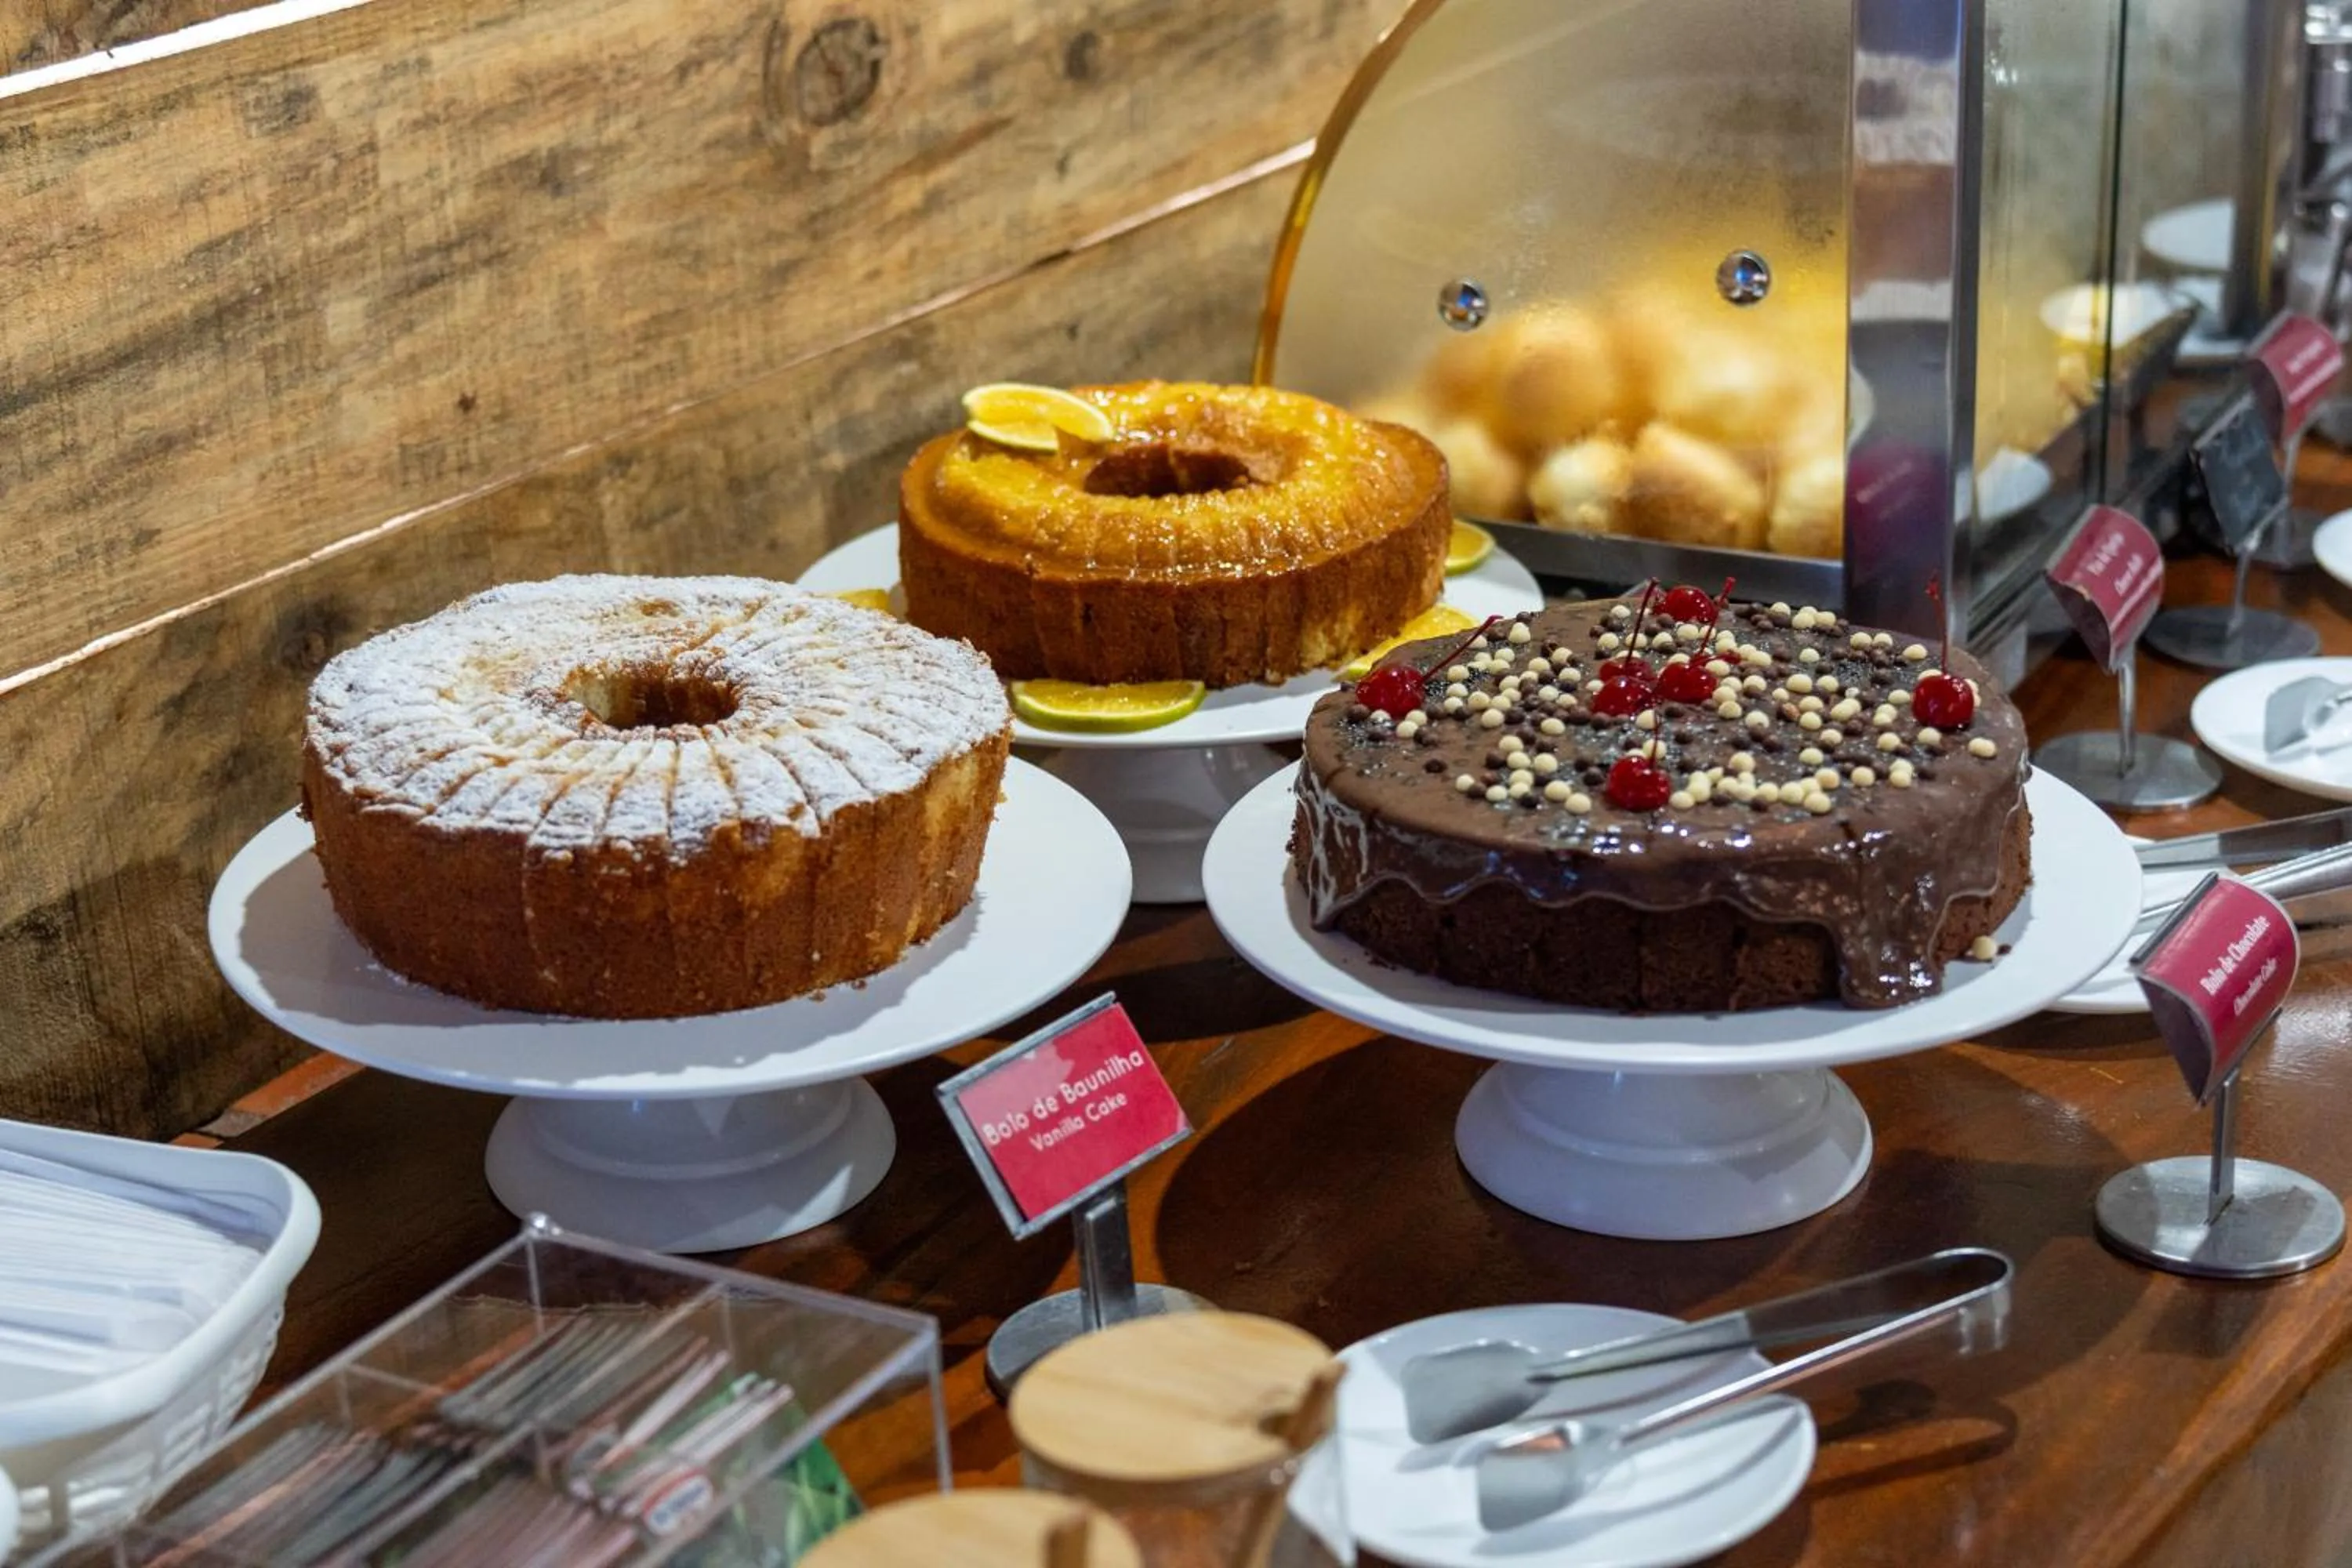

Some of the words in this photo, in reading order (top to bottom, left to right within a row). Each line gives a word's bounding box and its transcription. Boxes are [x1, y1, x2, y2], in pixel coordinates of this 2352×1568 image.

[2227, 915, 2270, 961] Chocolate
[982, 1112, 1029, 1145] Bolo
[1033, 1096, 1059, 1120] de
[1059, 1050, 1144, 1104] Baunilha
[1029, 1116, 1085, 1151] Vanilla
[1085, 1093, 1127, 1121] Cake
